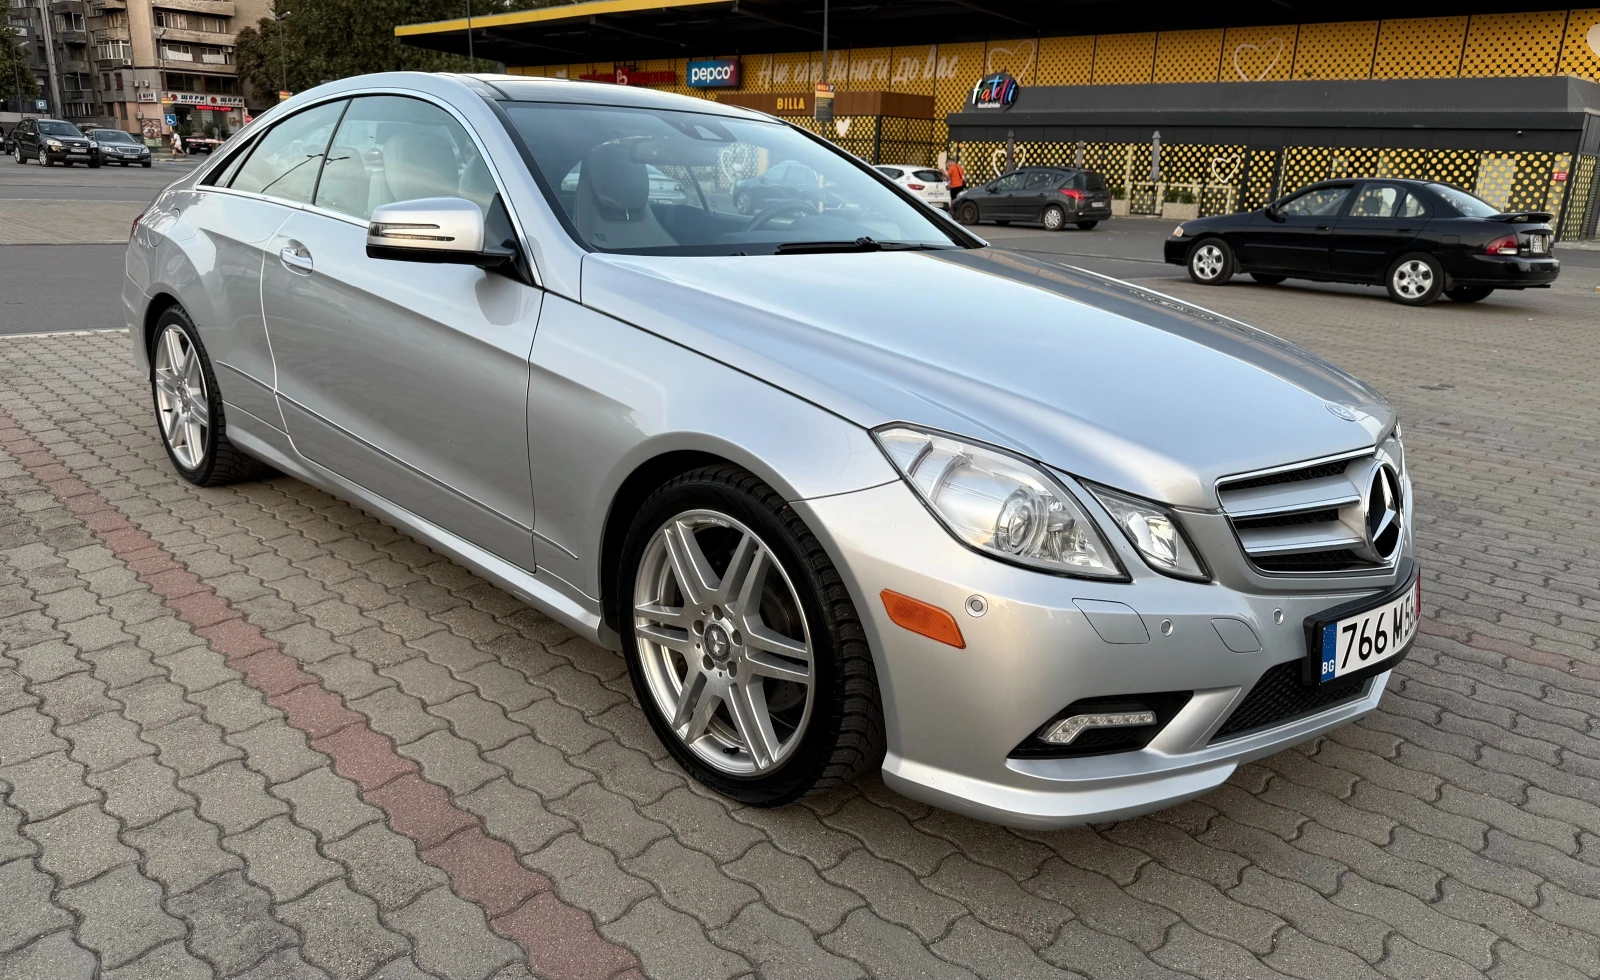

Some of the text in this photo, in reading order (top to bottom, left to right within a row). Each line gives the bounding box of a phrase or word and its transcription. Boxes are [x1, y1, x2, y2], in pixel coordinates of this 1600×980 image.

[691, 66, 731, 84] pepco
[891, 57, 920, 86] до
[776, 97, 806, 110] BILLA
[1341, 611, 1388, 670] 766
[1392, 602, 1404, 649] M
[1322, 659, 1335, 675] BG
